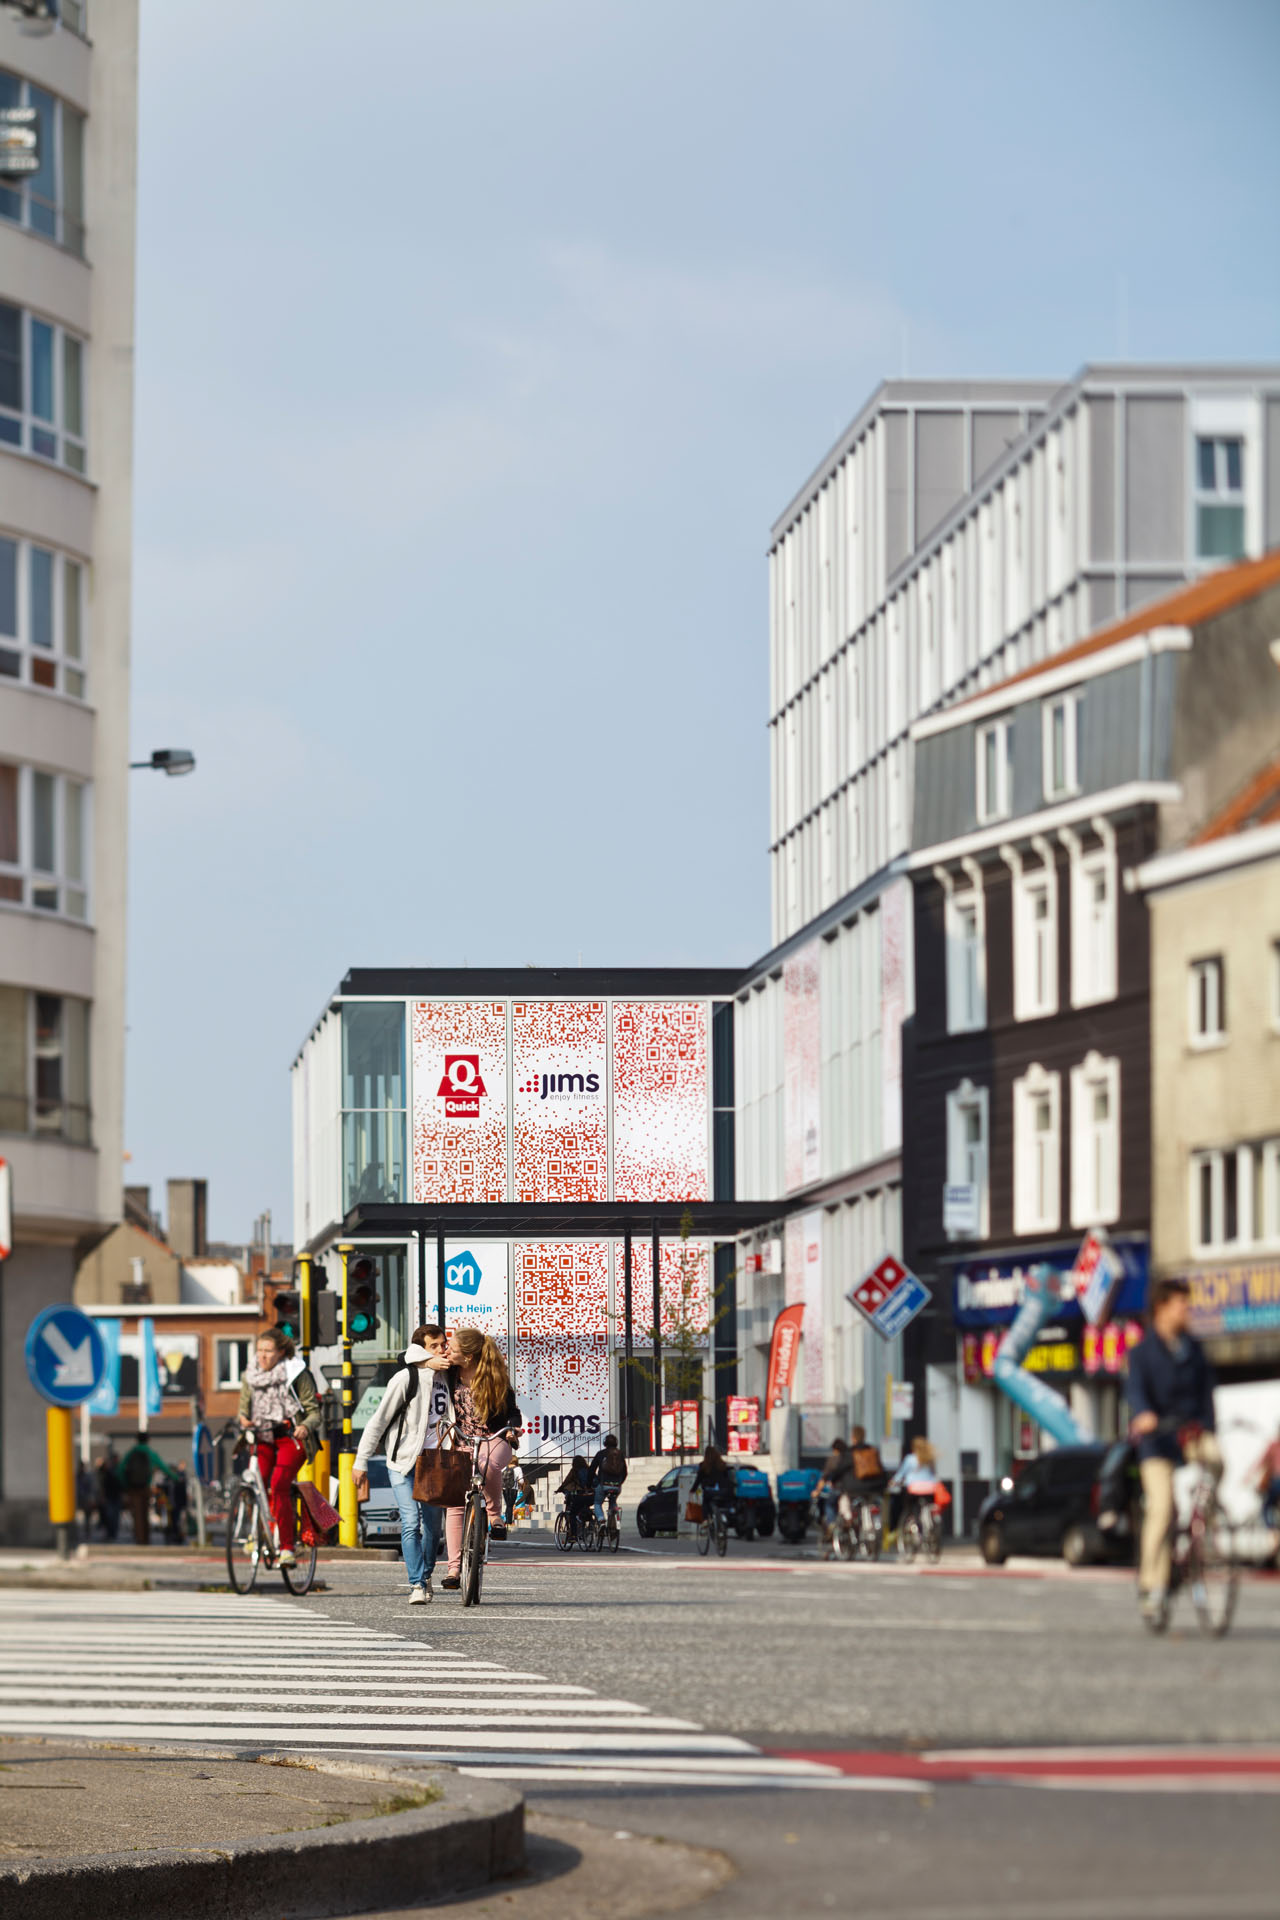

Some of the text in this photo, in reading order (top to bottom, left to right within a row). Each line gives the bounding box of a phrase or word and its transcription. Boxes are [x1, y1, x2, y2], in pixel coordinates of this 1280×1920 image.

[448, 1059, 479, 1094] Q
[446, 1100, 479, 1113] Quick
[432, 1304, 493, 1315] Abert Heijn
